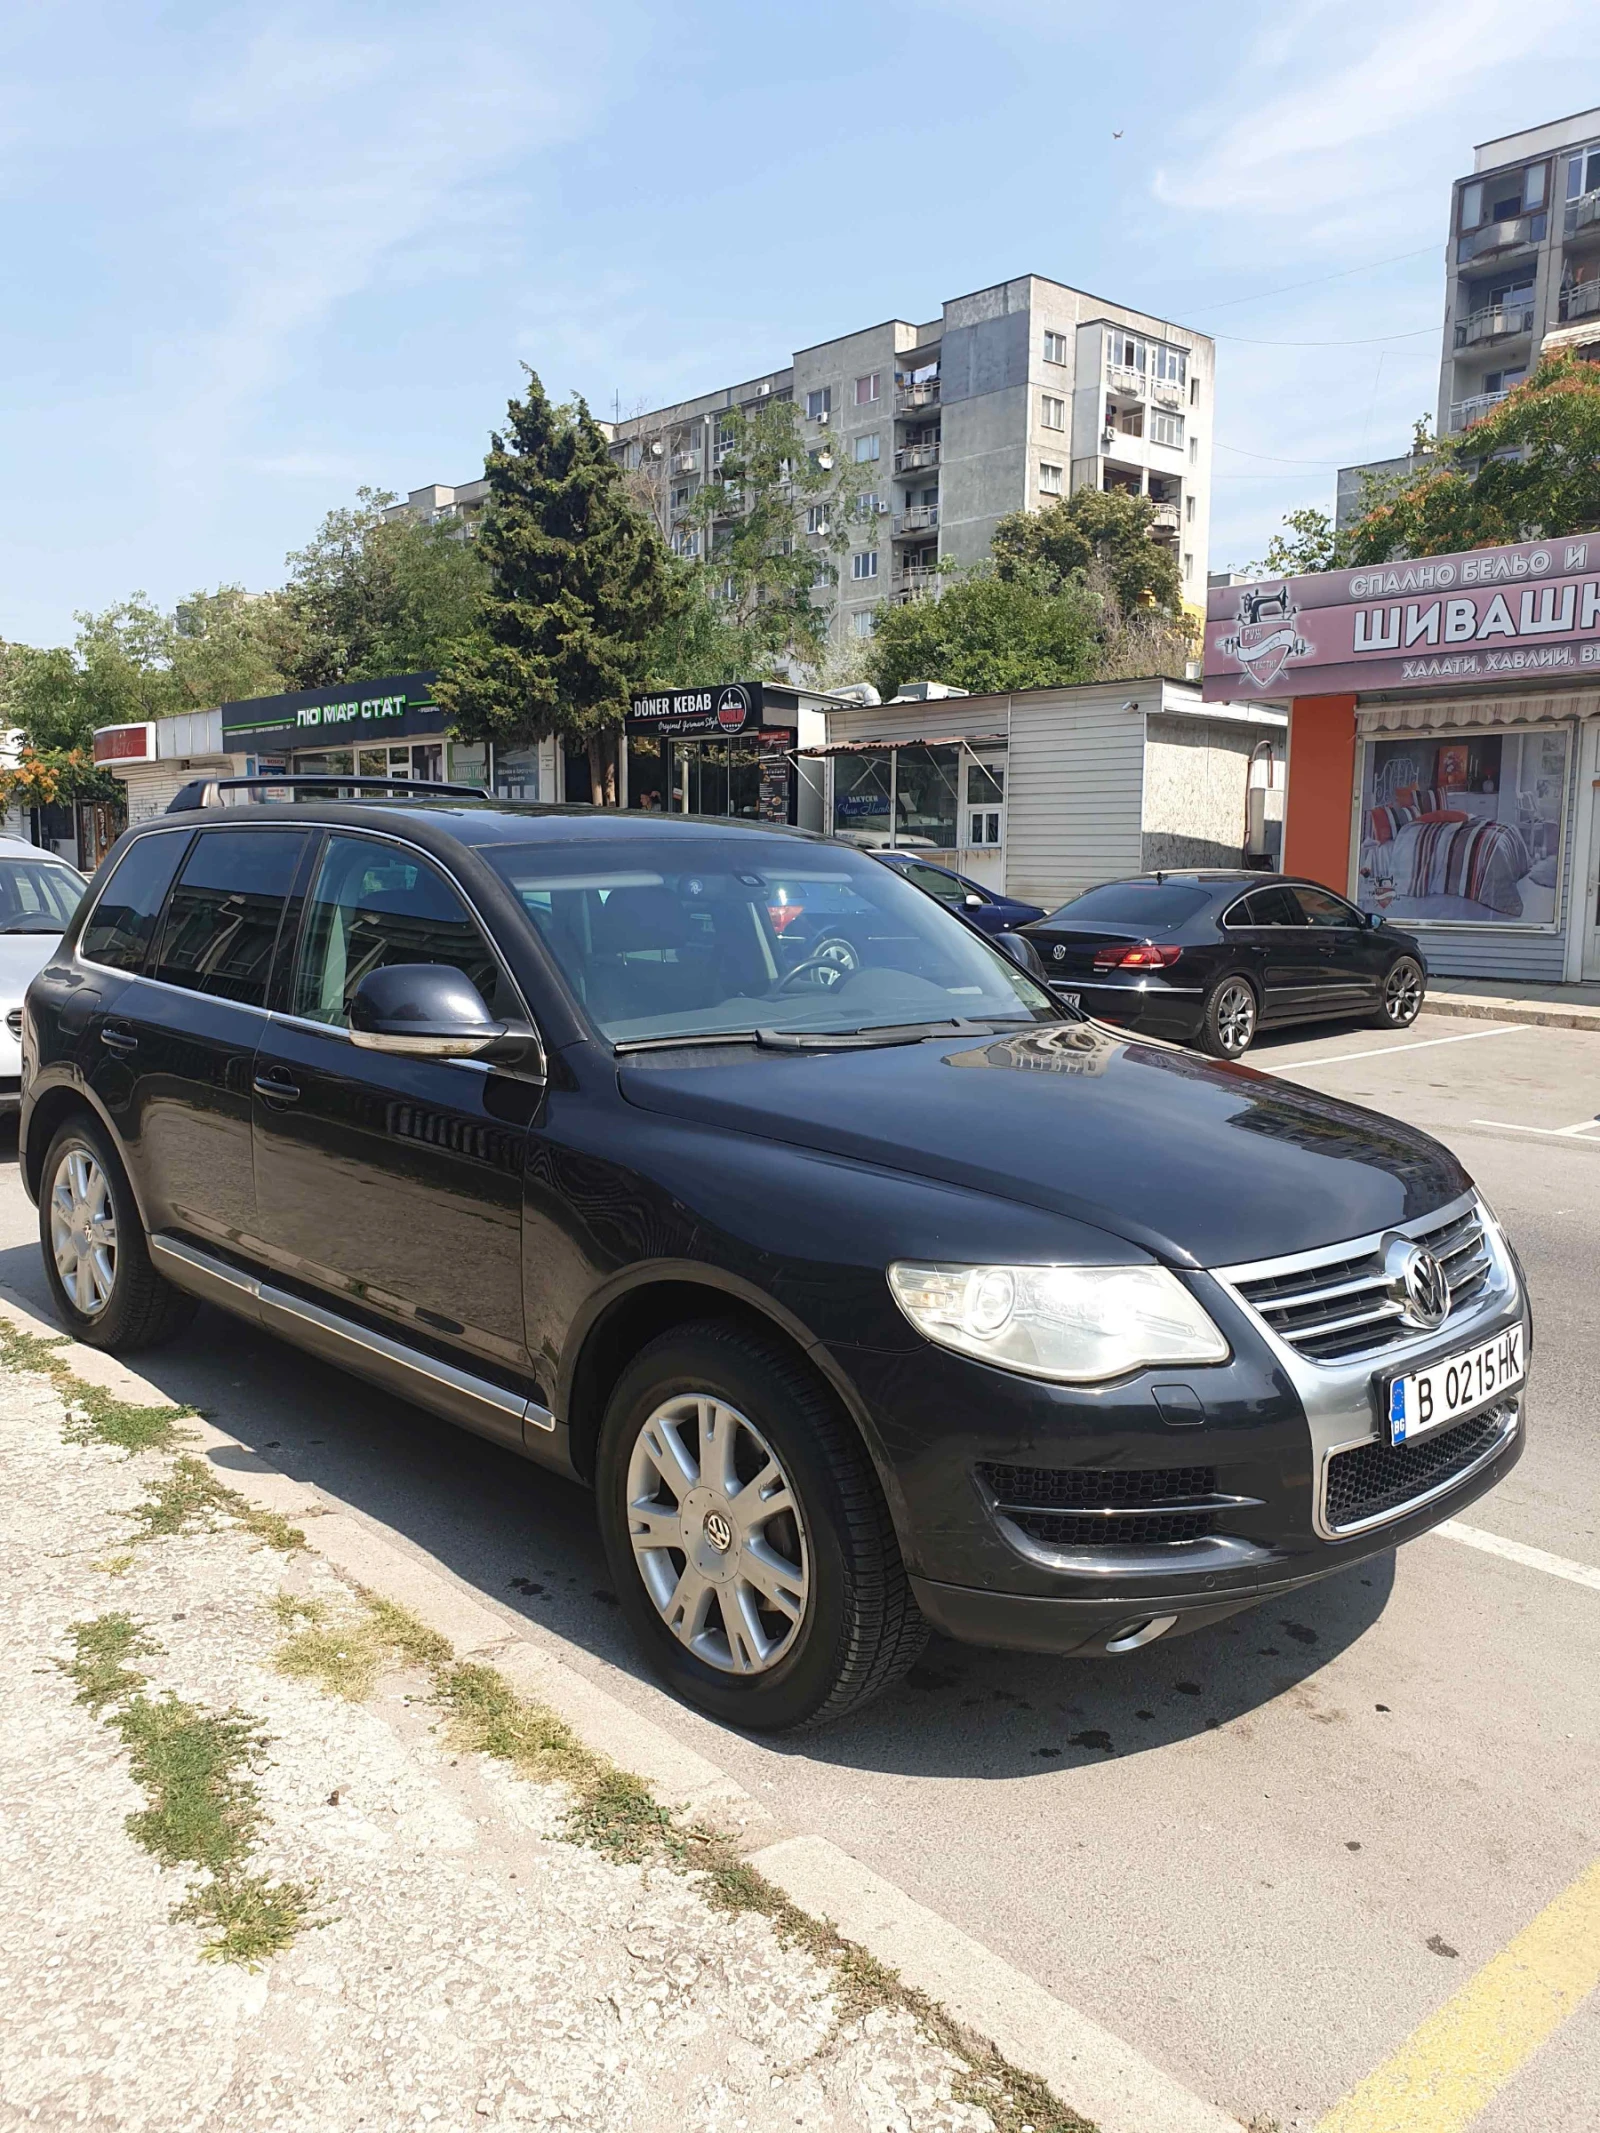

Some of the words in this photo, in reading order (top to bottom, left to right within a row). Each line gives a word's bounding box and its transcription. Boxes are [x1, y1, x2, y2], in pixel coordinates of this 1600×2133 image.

[1350, 564, 1456, 598] СПАЛНО
[1463, 550, 1551, 584] БЕЛЬО
[1565, 544, 1588, 571] И
[1244, 628, 1262, 641] РУЖ
[1402, 656, 1481, 680] ХАЛАТИ,
[1485, 646, 1576, 671] ХАВЛИИ,
[296, 706, 321, 728] ЛЮ
[323, 701, 359, 723] МАР
[361, 695, 405, 719] СТАТ
[634, 696, 670, 717] DÖNER
[673, 693, 712, 714] KEBAB
[1418, 1377, 1433, 1425] B
[1393, 1418, 1406, 1435] BG
